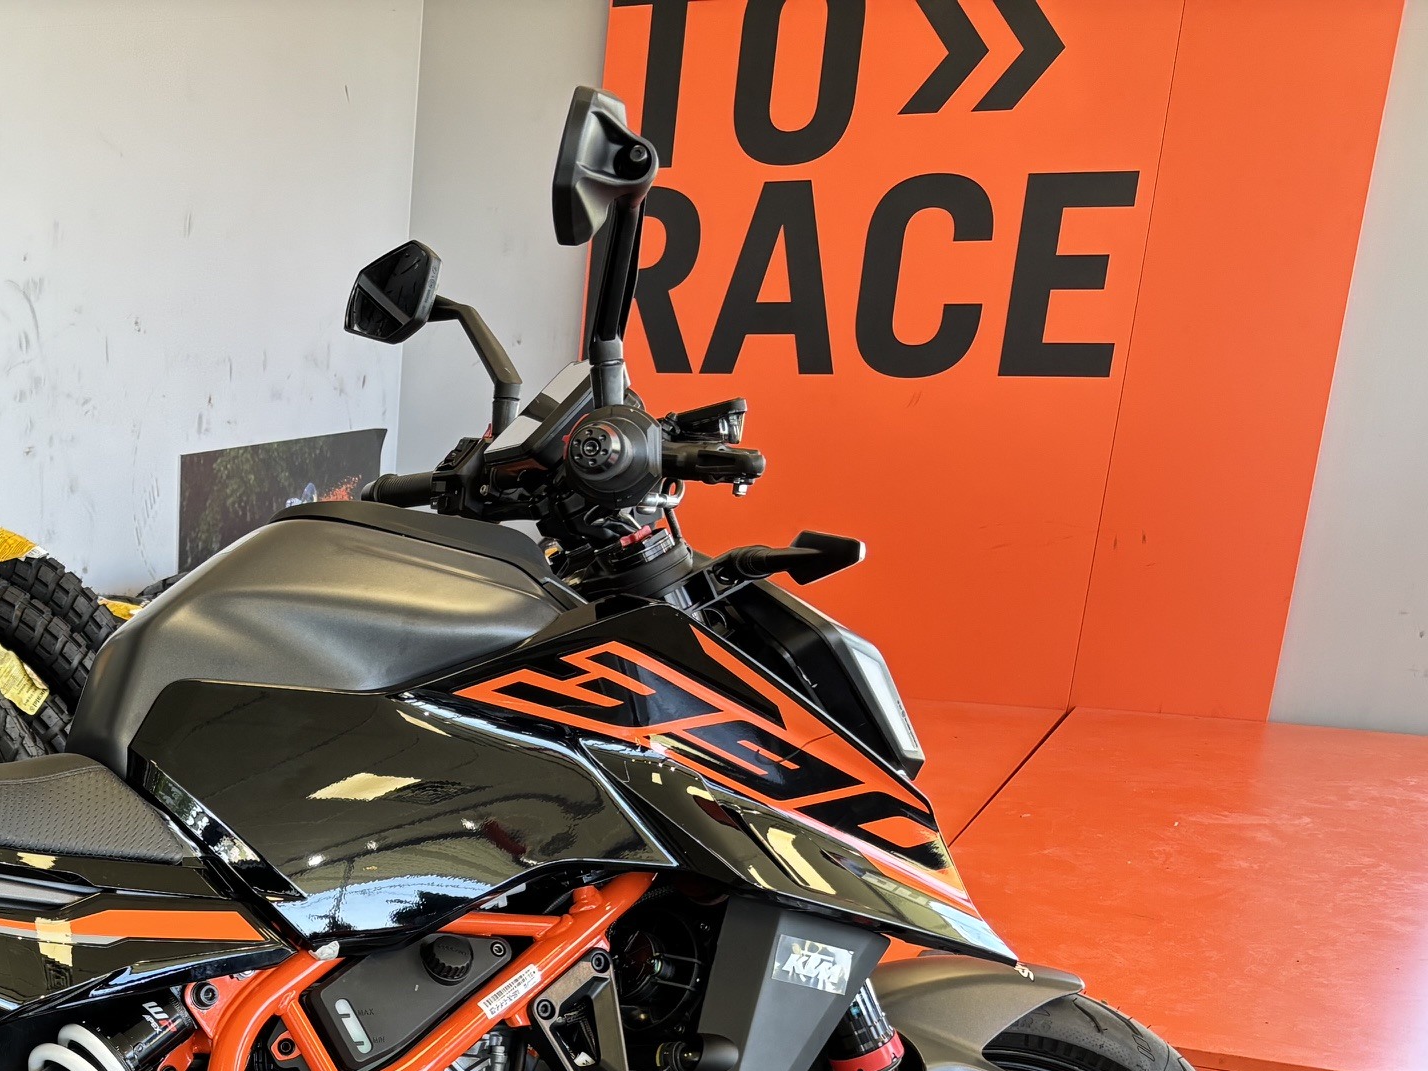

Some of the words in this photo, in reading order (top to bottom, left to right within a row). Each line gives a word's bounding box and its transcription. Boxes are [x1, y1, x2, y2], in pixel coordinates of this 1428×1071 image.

[610, 0, 866, 167] TO
[590, 171, 1140, 378] RACE
[781, 952, 843, 984] KTM
